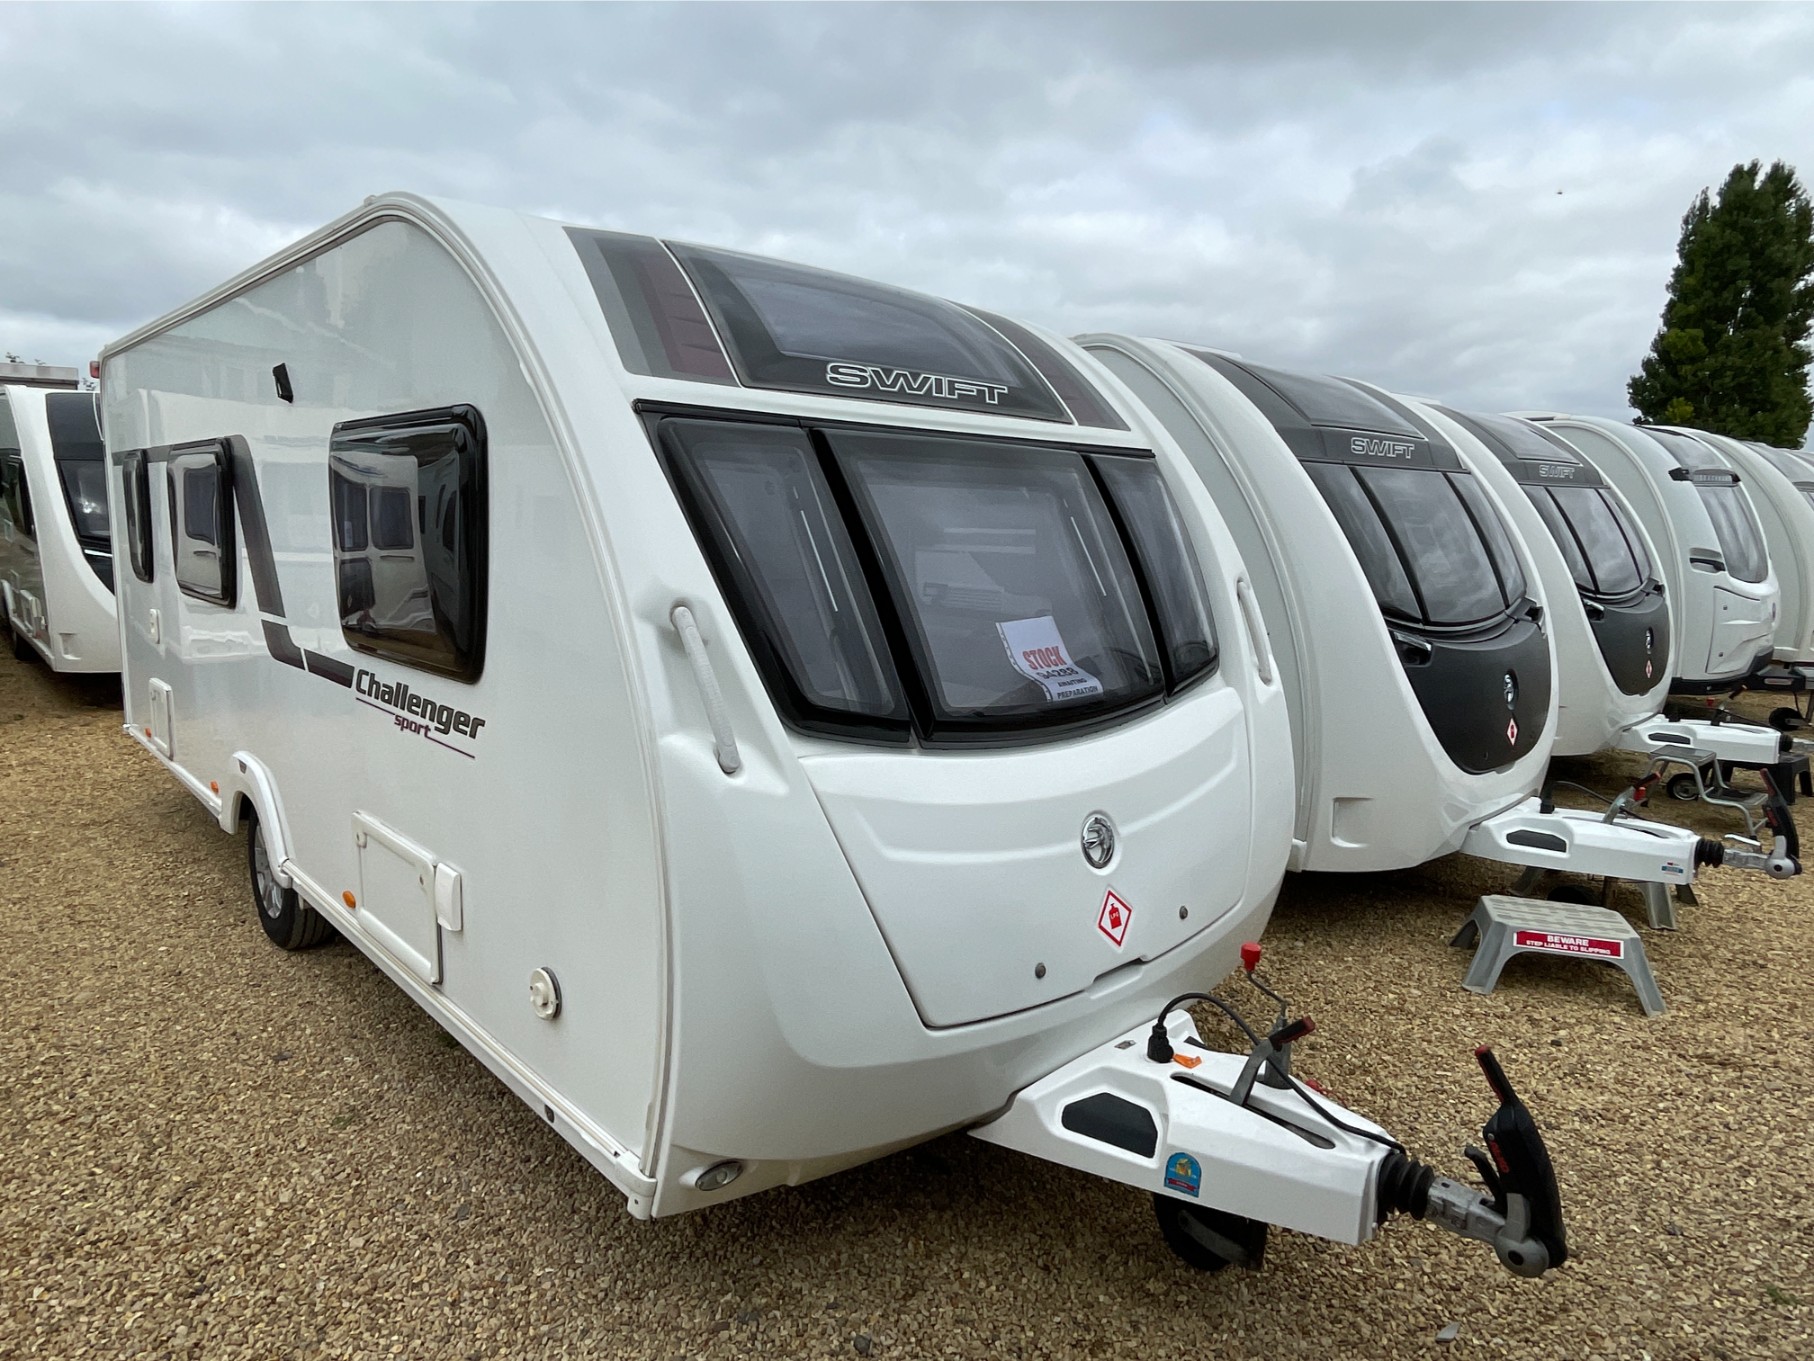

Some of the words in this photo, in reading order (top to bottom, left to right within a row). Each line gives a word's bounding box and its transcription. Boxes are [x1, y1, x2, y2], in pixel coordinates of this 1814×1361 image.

[826, 362, 1008, 405] SWIFT
[1350, 436, 1415, 459] SWIFT
[1539, 464, 1575, 479] SWIFT
[1022, 646, 1068, 670] STOCK
[355, 668, 486, 740] Challenger
[1057, 686, 1098, 699] PREPARATION
[394, 714, 431, 738] sport
[1547, 935, 1589, 946] BEWARE
